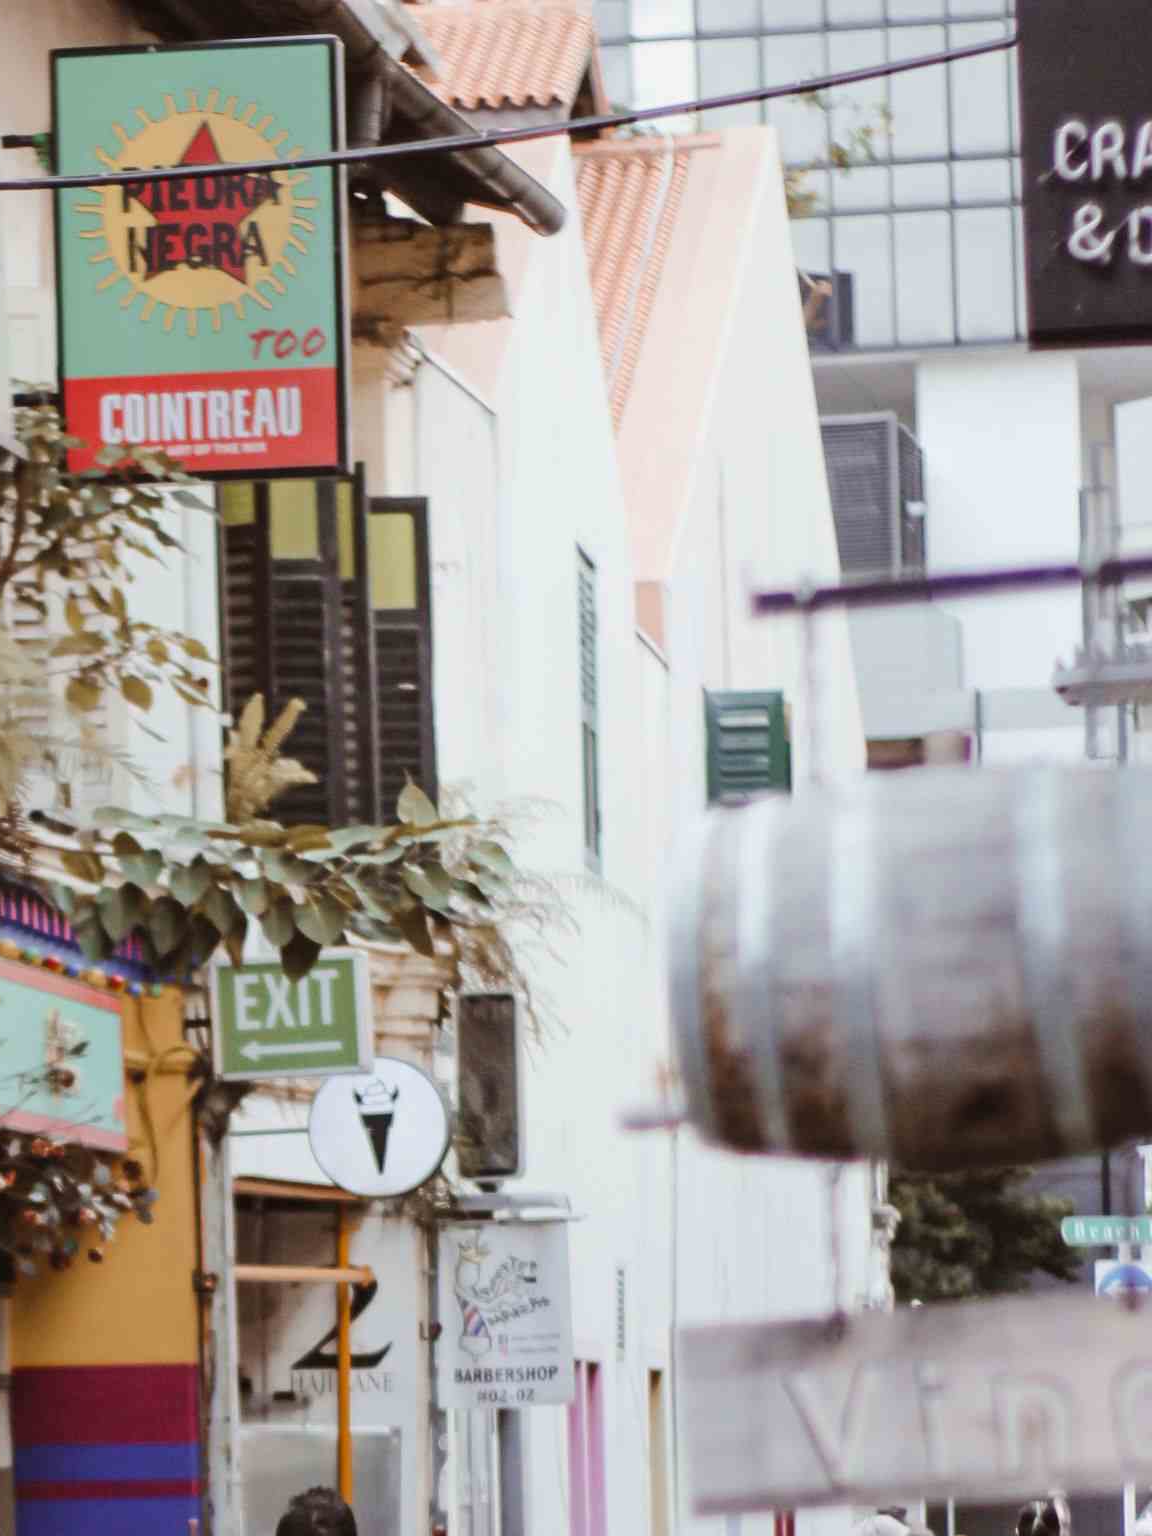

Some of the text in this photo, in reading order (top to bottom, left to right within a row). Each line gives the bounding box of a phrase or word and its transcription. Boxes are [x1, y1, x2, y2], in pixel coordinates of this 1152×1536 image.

[121, 164, 282, 214] PIEDRA
[127, 222, 269, 272] NEGRA
[1068, 201, 1115, 263] &
[250, 327, 326, 360] TOO
[100, 387, 302, 445] COINTREAU
[234, 969, 339, 1031] EXIT
[454, 1365, 559, 1384] BARBERSHOP
